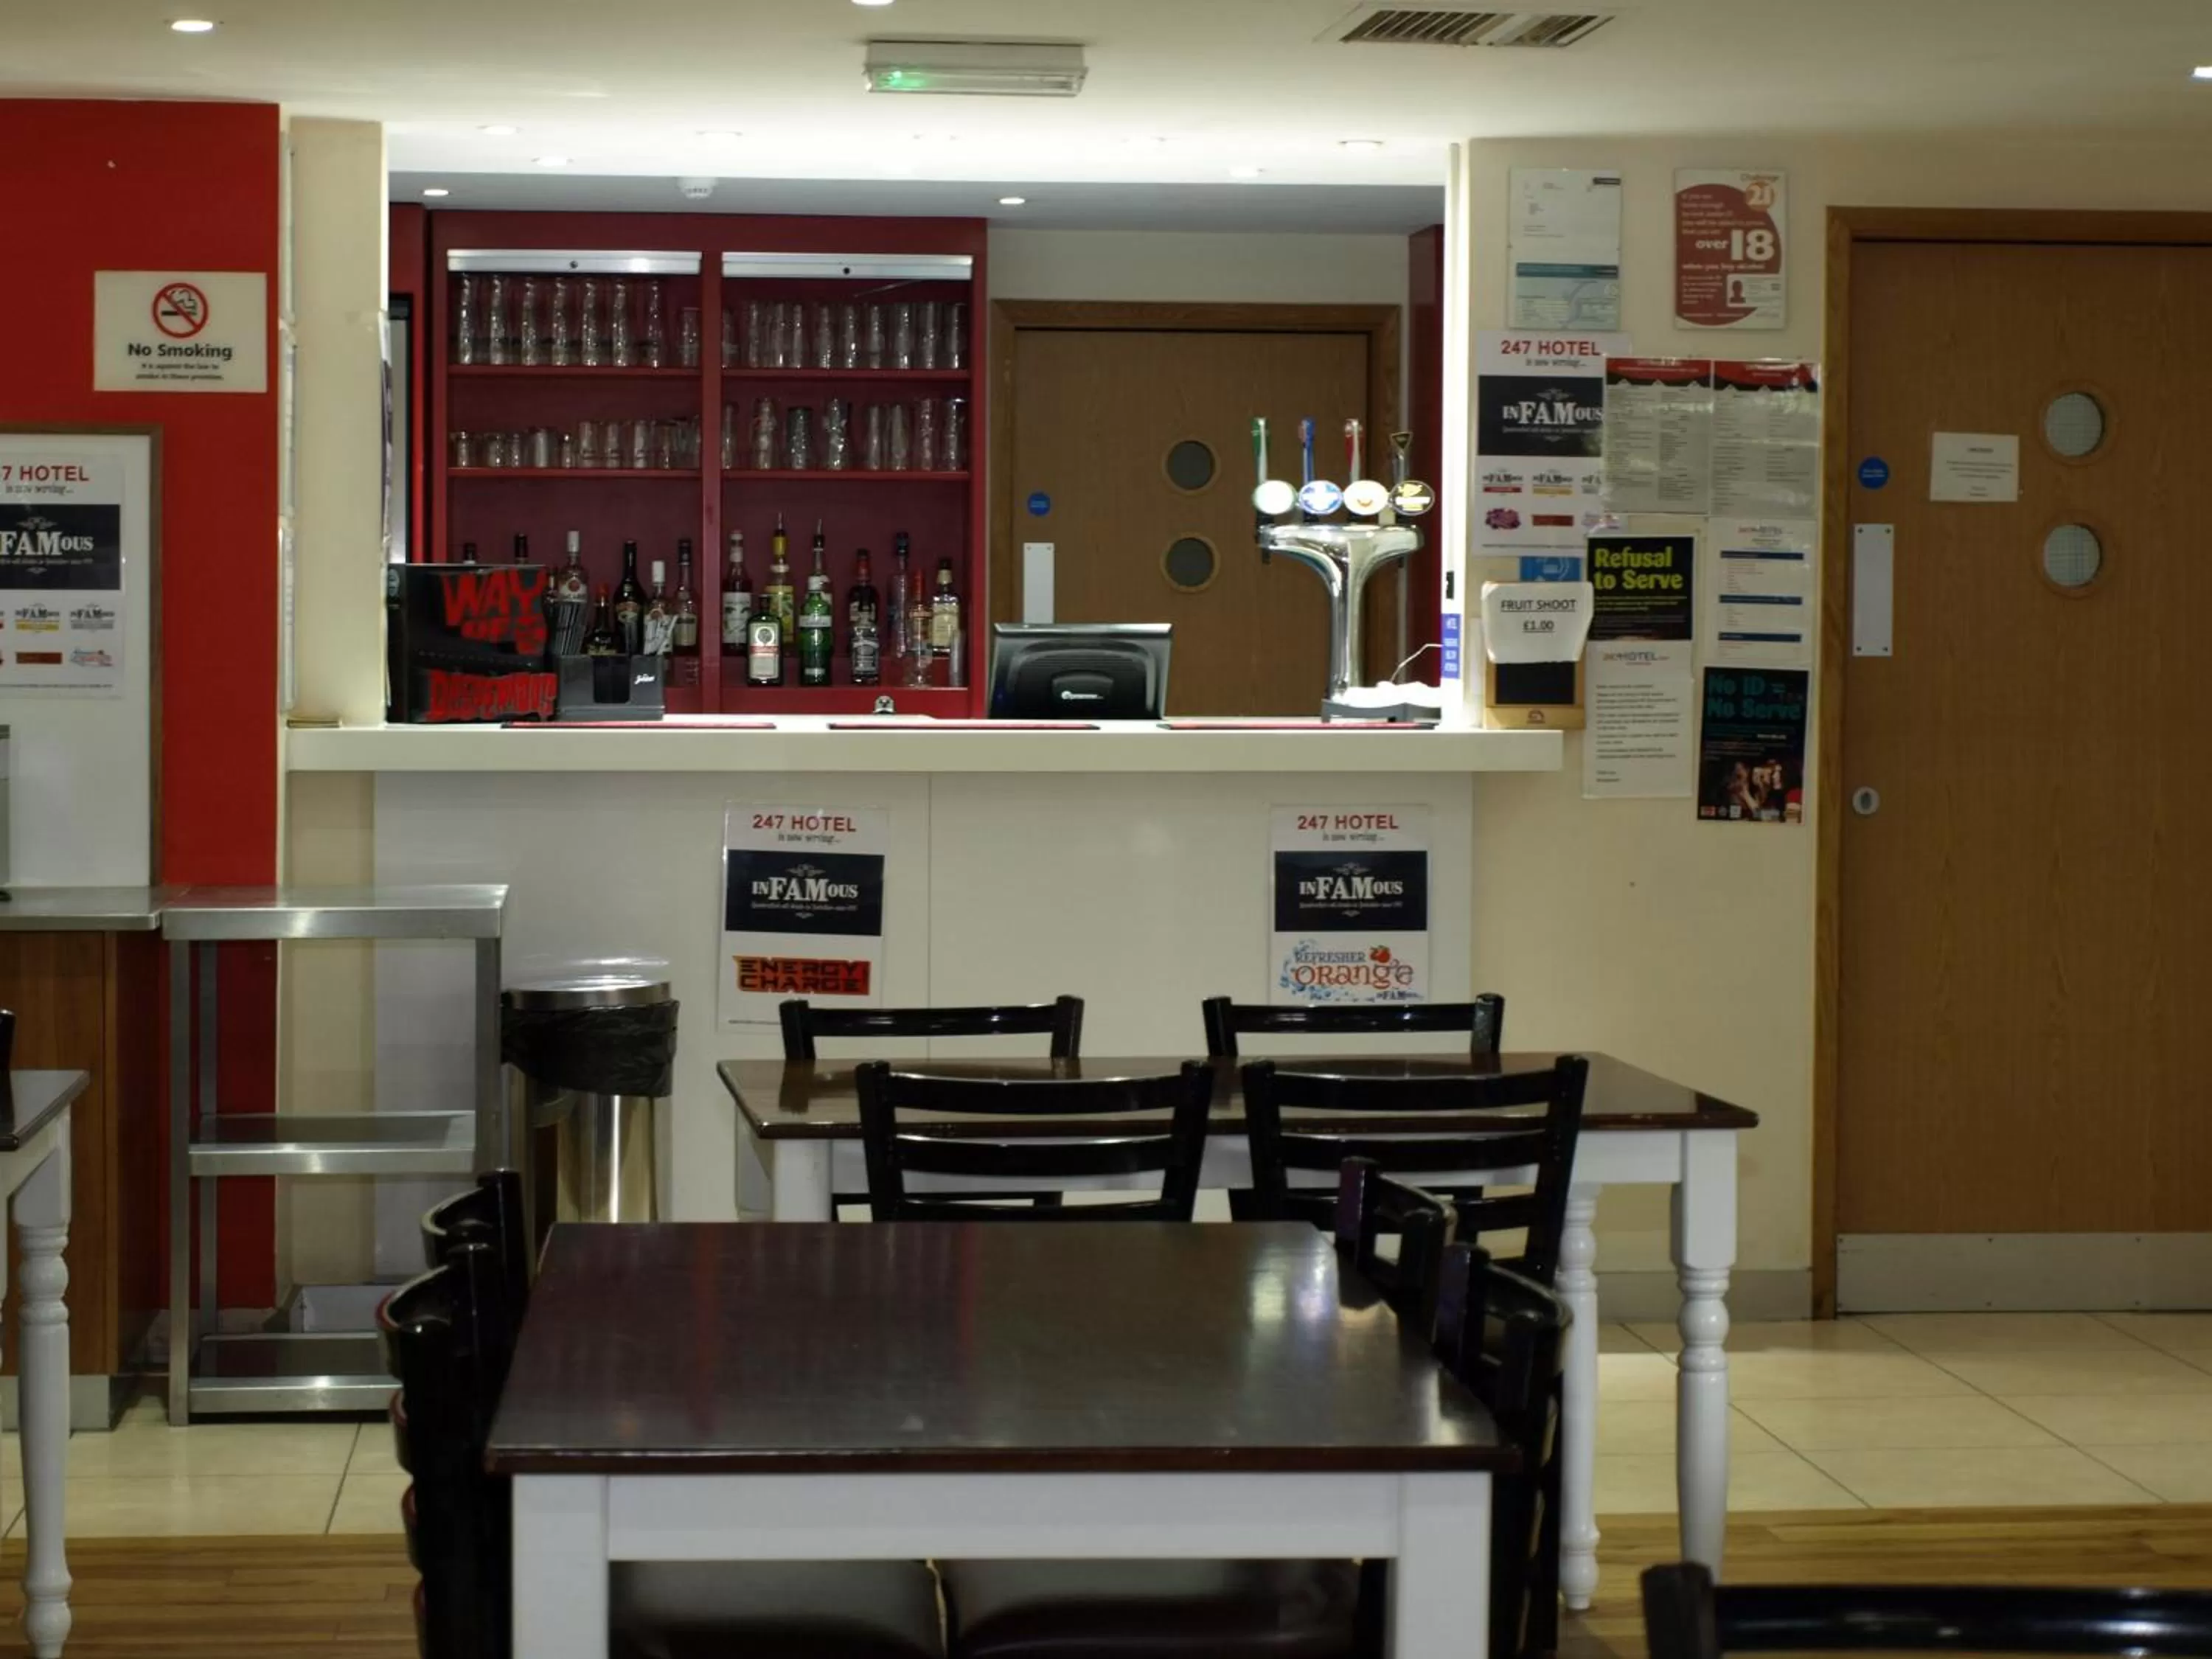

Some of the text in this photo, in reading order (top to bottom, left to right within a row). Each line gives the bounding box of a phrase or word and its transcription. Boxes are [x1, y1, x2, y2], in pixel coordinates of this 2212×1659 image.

[1694, 229, 1775, 261] over 18
[128, 344, 232, 361] No Smoking
[1501, 341, 1601, 356] 247 HOTEL
[19, 465, 90, 481] HOTEL
[1593, 546, 1674, 568] Refusal
[1593, 568, 1684, 590] to Serve
[441, 567, 546, 627] WAY
[1500, 599, 1576, 611] FRUIT SHOOT
[1708, 674, 1736, 696] No
[1742, 675, 1766, 696] ID
[1707, 697, 1803, 720] No Serve
[751, 813, 857, 832] 247 HOTEL
[1297, 814, 1399, 830] 247 HOTEL
[740, 959, 861, 975] ENERGY
[740, 975, 861, 992] CHARGE
